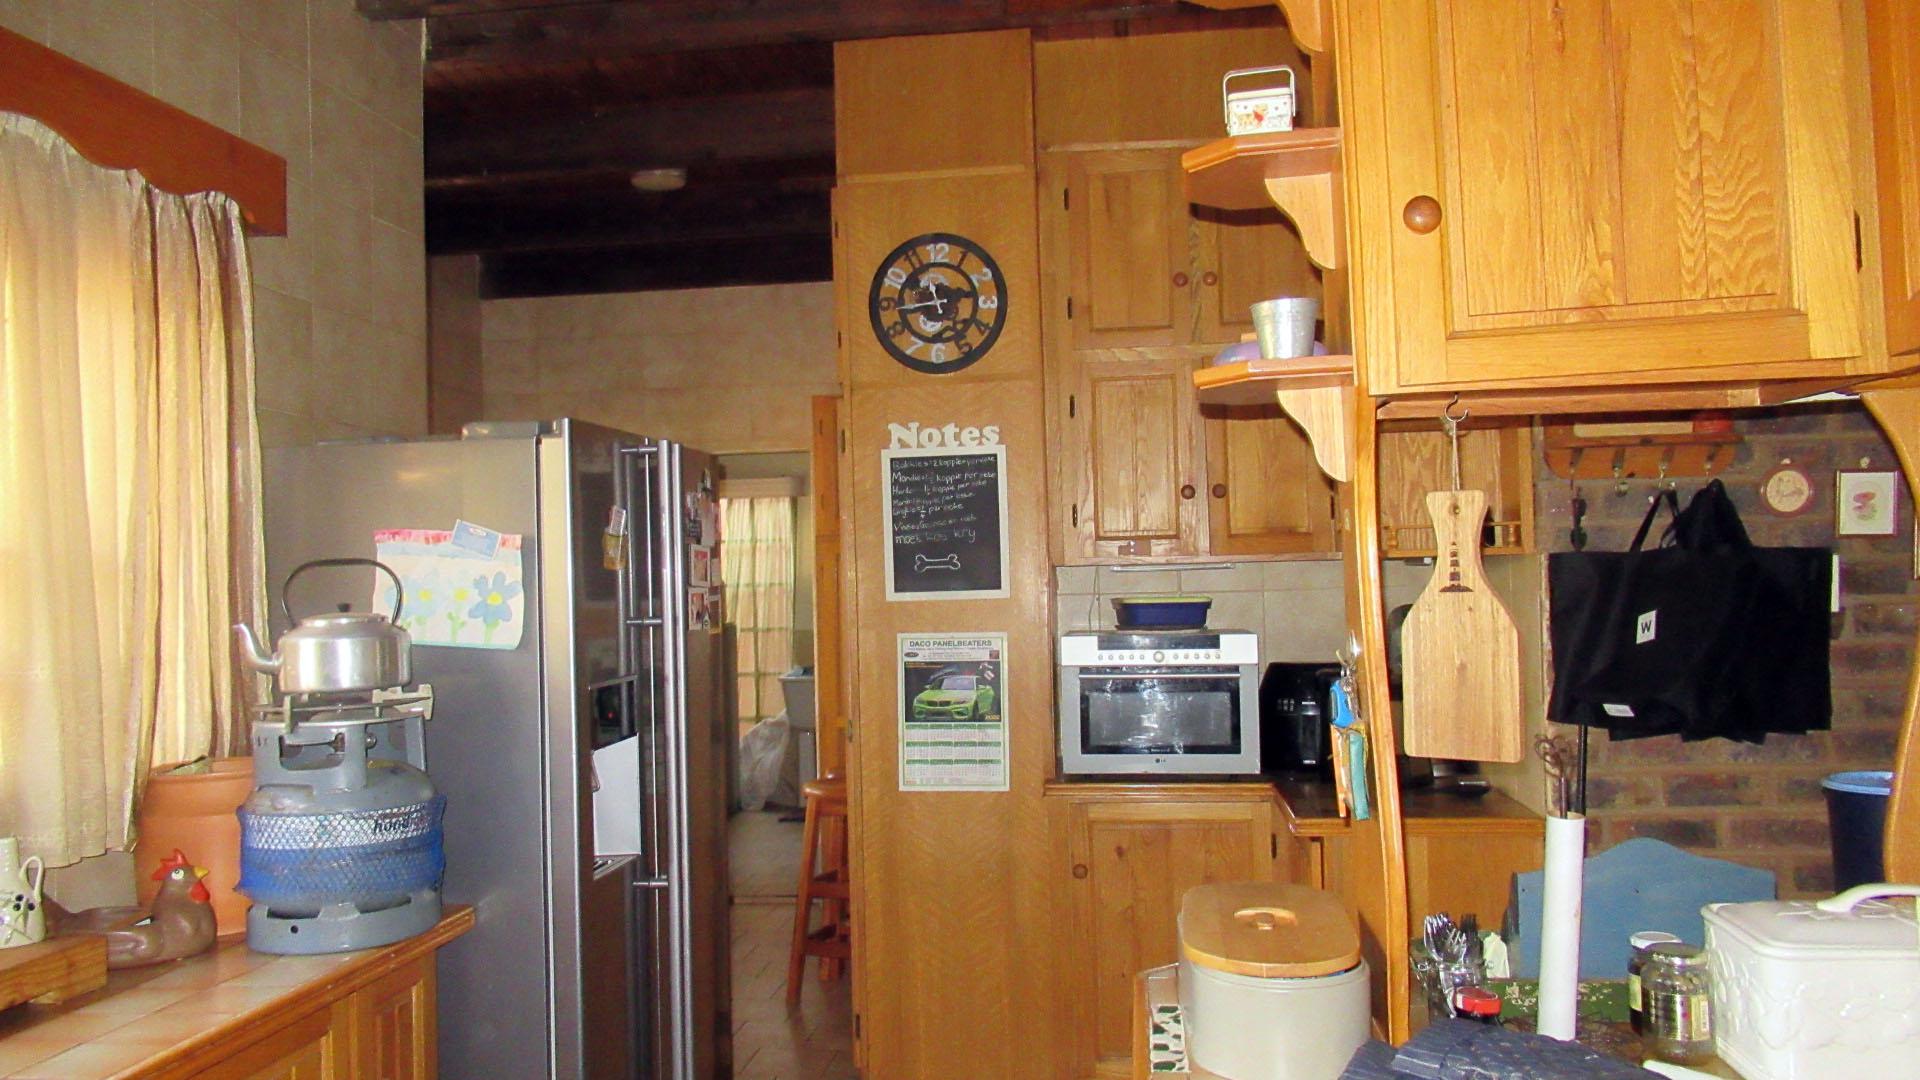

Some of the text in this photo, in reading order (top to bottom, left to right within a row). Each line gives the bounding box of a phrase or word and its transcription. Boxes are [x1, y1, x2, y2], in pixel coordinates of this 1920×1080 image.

[926, 242, 950, 263] 12
[884, 267, 907, 289] 10
[978, 295, 998, 309] 3
[904, 336, 925, 355] 7
[930, 342, 947, 364] 6
[887, 421, 1000, 449] Notes
[1641, 620, 1652, 634] W
[932, 639, 993, 647] PANELBEATERS
